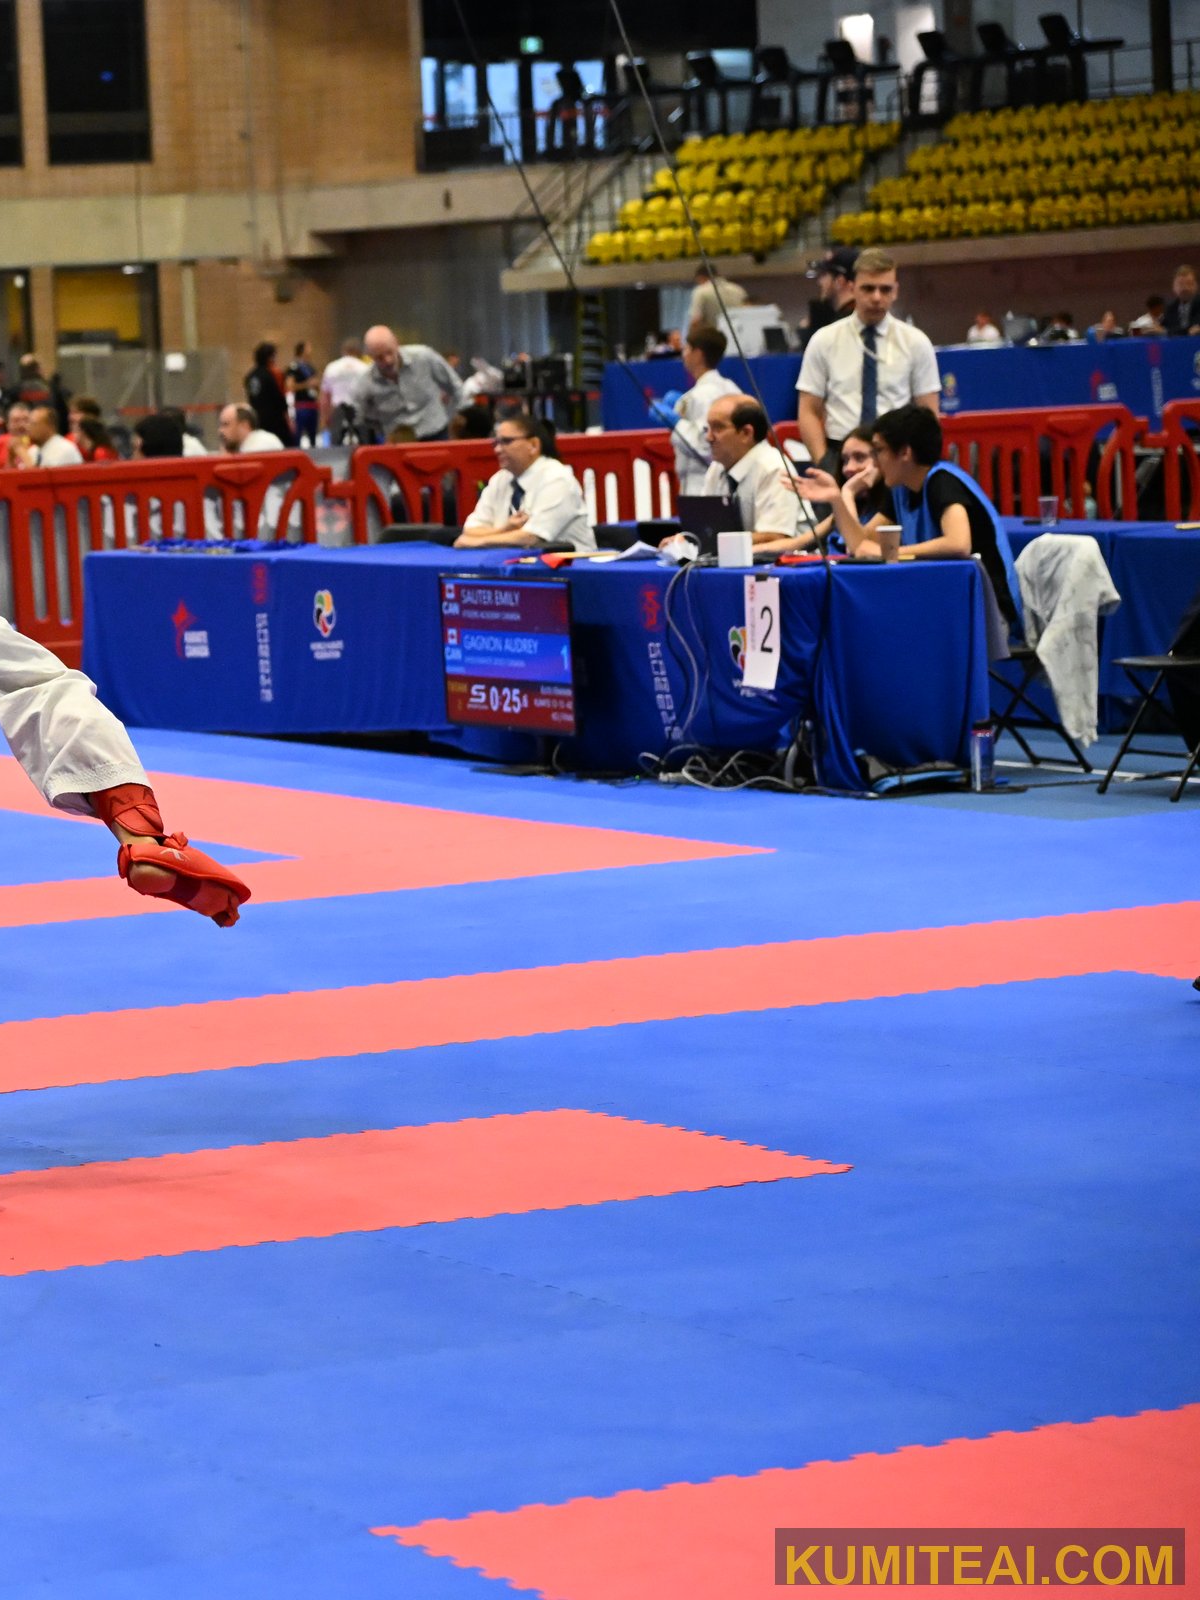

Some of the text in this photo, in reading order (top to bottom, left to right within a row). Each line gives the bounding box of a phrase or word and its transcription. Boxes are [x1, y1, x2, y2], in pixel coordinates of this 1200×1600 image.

[494, 590, 520, 607] EMILY
[442, 601, 460, 615] CAN
[760, 605, 773, 654] 2
[444, 646, 462, 660] CAN
[504, 637, 538, 655] AUDREY
[560, 644, 569, 670] 1
